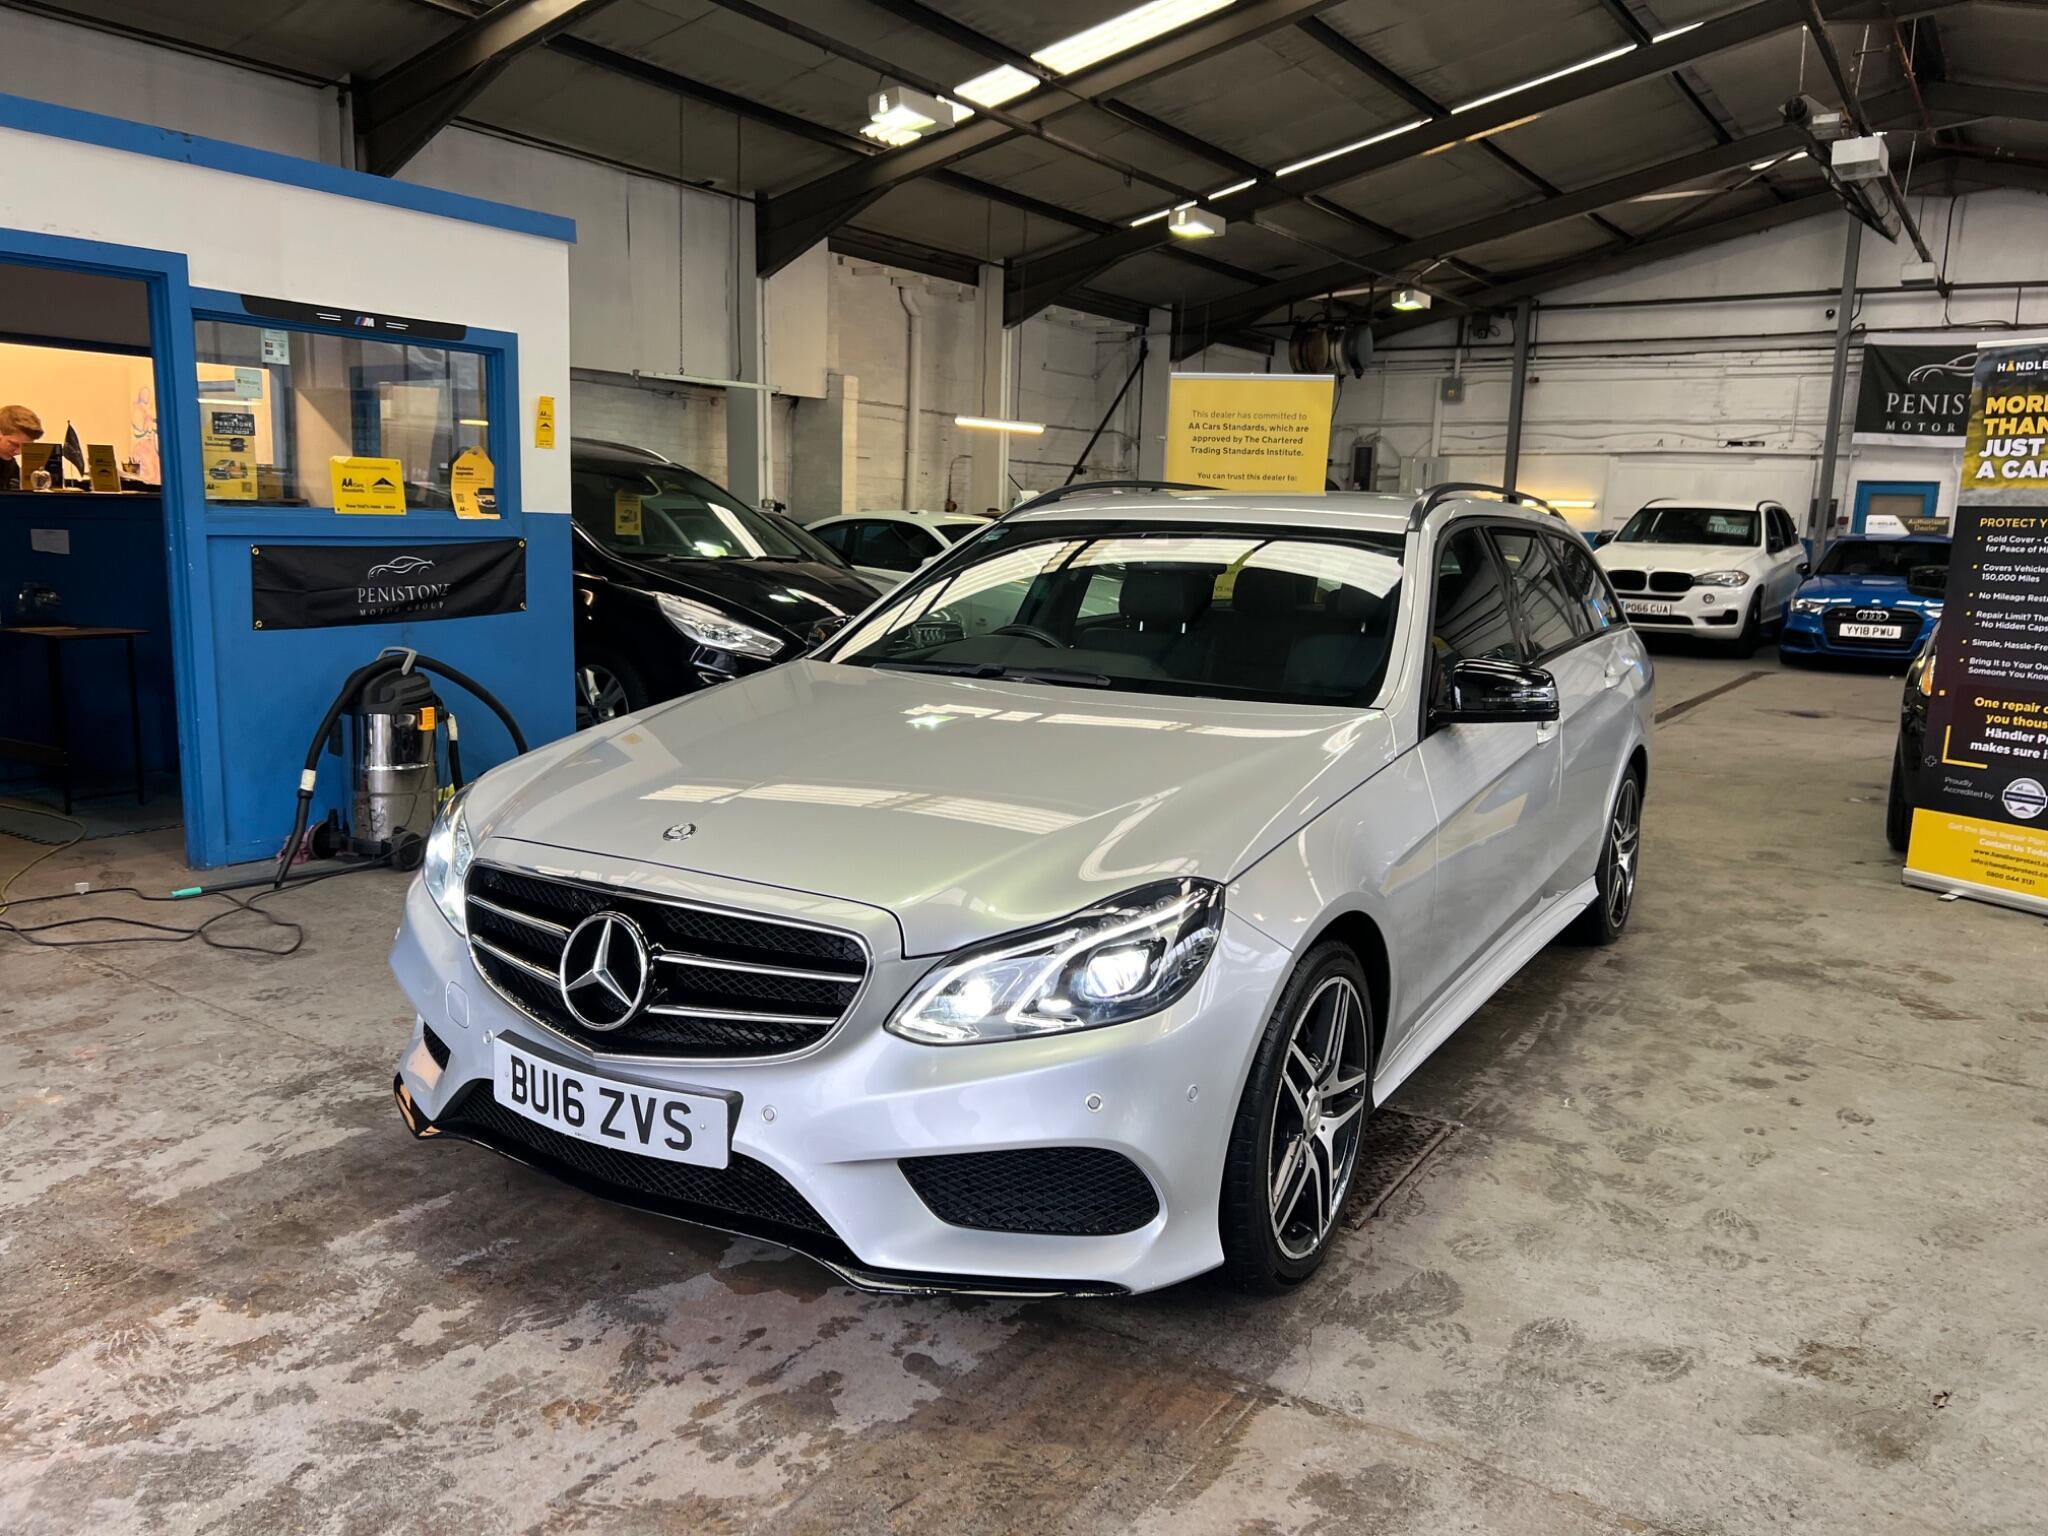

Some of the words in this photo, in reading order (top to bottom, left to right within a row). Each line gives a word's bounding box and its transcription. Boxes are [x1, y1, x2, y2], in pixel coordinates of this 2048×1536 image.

[1886, 392, 1972, 415] PENIS
[1210, 410, 1236, 419] dealer
[1238, 411, 1251, 420] has
[1252, 412, 1297, 420] committed
[1202, 422, 1220, 430] Cars
[1222, 422, 1268, 432] Standards,
[1269, 424, 1294, 432] which
[1885, 421, 1955, 433] MOTOR
[1192, 435, 1231, 444] approved
[1232, 436, 1242, 444] by
[1244, 436, 1260, 444] The
[1262, 436, 1304, 445] Chartered
[1190, 446, 1220, 456] Trading
[1222, 447, 1265, 456] Standards
[1266, 448, 1304, 456] Institute.
[1978, 438, 2046, 458] JUST
[1975, 460, 1996, 479] A
[1980, 518, 2036, 528] PROTECT
[2040, 518, 2048, 528] Y
[1986, 534, 2008, 544] Gold
[2009, 535, 2036, 544] Cover
[1986, 544, 1999, 552] for
[2000, 544, 2026, 553] Peace
[2028, 546, 2038, 554] of
[1982, 563, 2012, 572] Covers
[2014, 564, 2048, 574] Vehicles
[1982, 573, 2017, 582] 150,000
[2018, 574, 2040, 583] Miles
[1978, 592, 1991, 600] No
[1993, 592, 2026, 602] Mileage
[1650, 603, 1668, 614] CUA
[1976, 610, 2004, 620] Repair
[2005, 612, 2032, 621] Limit?
[1847, 625, 1870, 636] YY18
[1872, 626, 1894, 637] PWU
[1981, 620, 1994, 628] No
[1996, 622, 2026, 631] Hidden
[2027, 624, 2048, 633] Caps
[1972, 638, 2002, 648] Simple,
[1970, 656, 1992, 667] Bring
[2002, 660, 2012, 668] to
[2013, 660, 2034, 670] Your
[1968, 666, 2006, 677] Someone
[2008, 670, 2026, 679] You
[1974, 696, 2000, 708] One
[2002, 702, 2042, 713] repair
[1986, 714, 2010, 724] you
[2012, 716, 2048, 730] thous
[1985, 727, 2036, 742] Händler
[1970, 742, 2011, 754] makes
[2013, 747, 2040, 759] sure
[1944, 776, 1974, 788] Proudly
[1943, 786, 1984, 798] Accredited
[1984, 792, 1996, 801] by
[1979, 838, 2012, 851] Contact
[510, 1054, 585, 1128] BU16
[599, 1086, 692, 1152] ZVS
